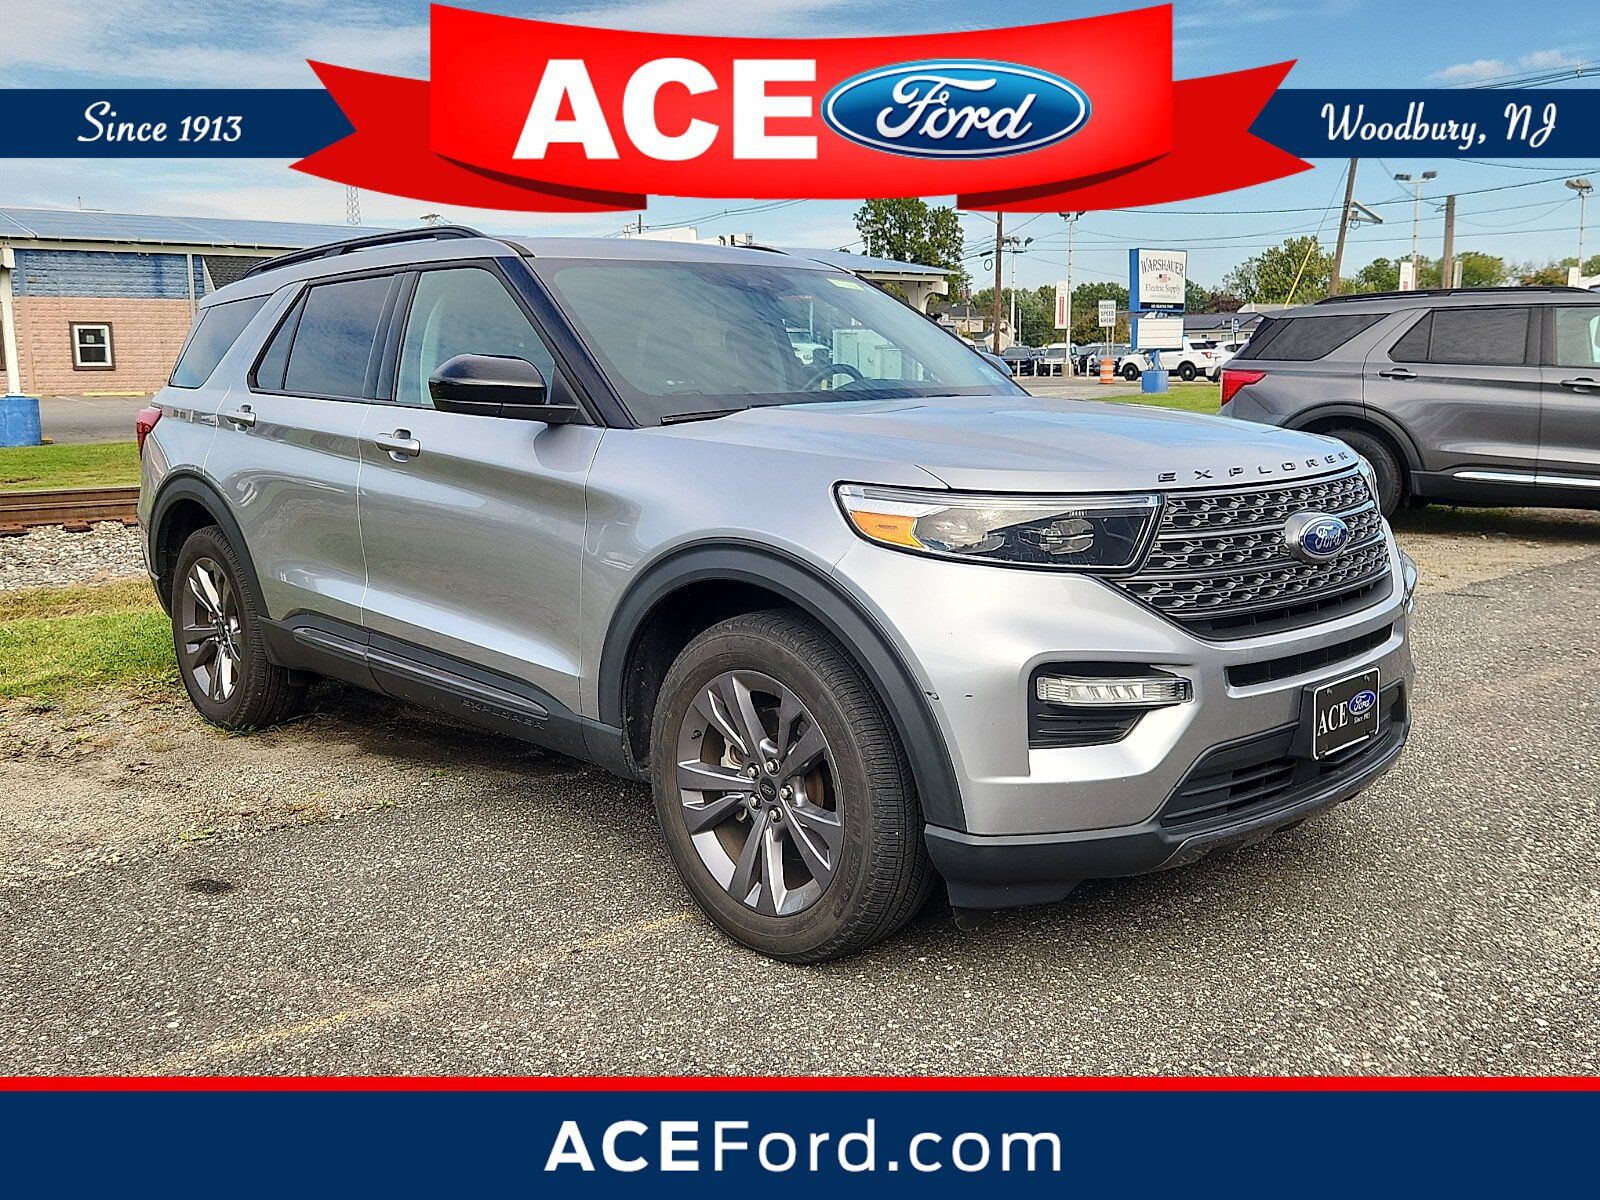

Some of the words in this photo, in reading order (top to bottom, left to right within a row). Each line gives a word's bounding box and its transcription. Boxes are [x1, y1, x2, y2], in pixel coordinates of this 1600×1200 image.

[1157, 451, 1350, 483] EXPLORER
[1314, 524, 1343, 550] Ford
[461, 700, 544, 730] EXPLORER
[1317, 701, 1349, 737] ACE
